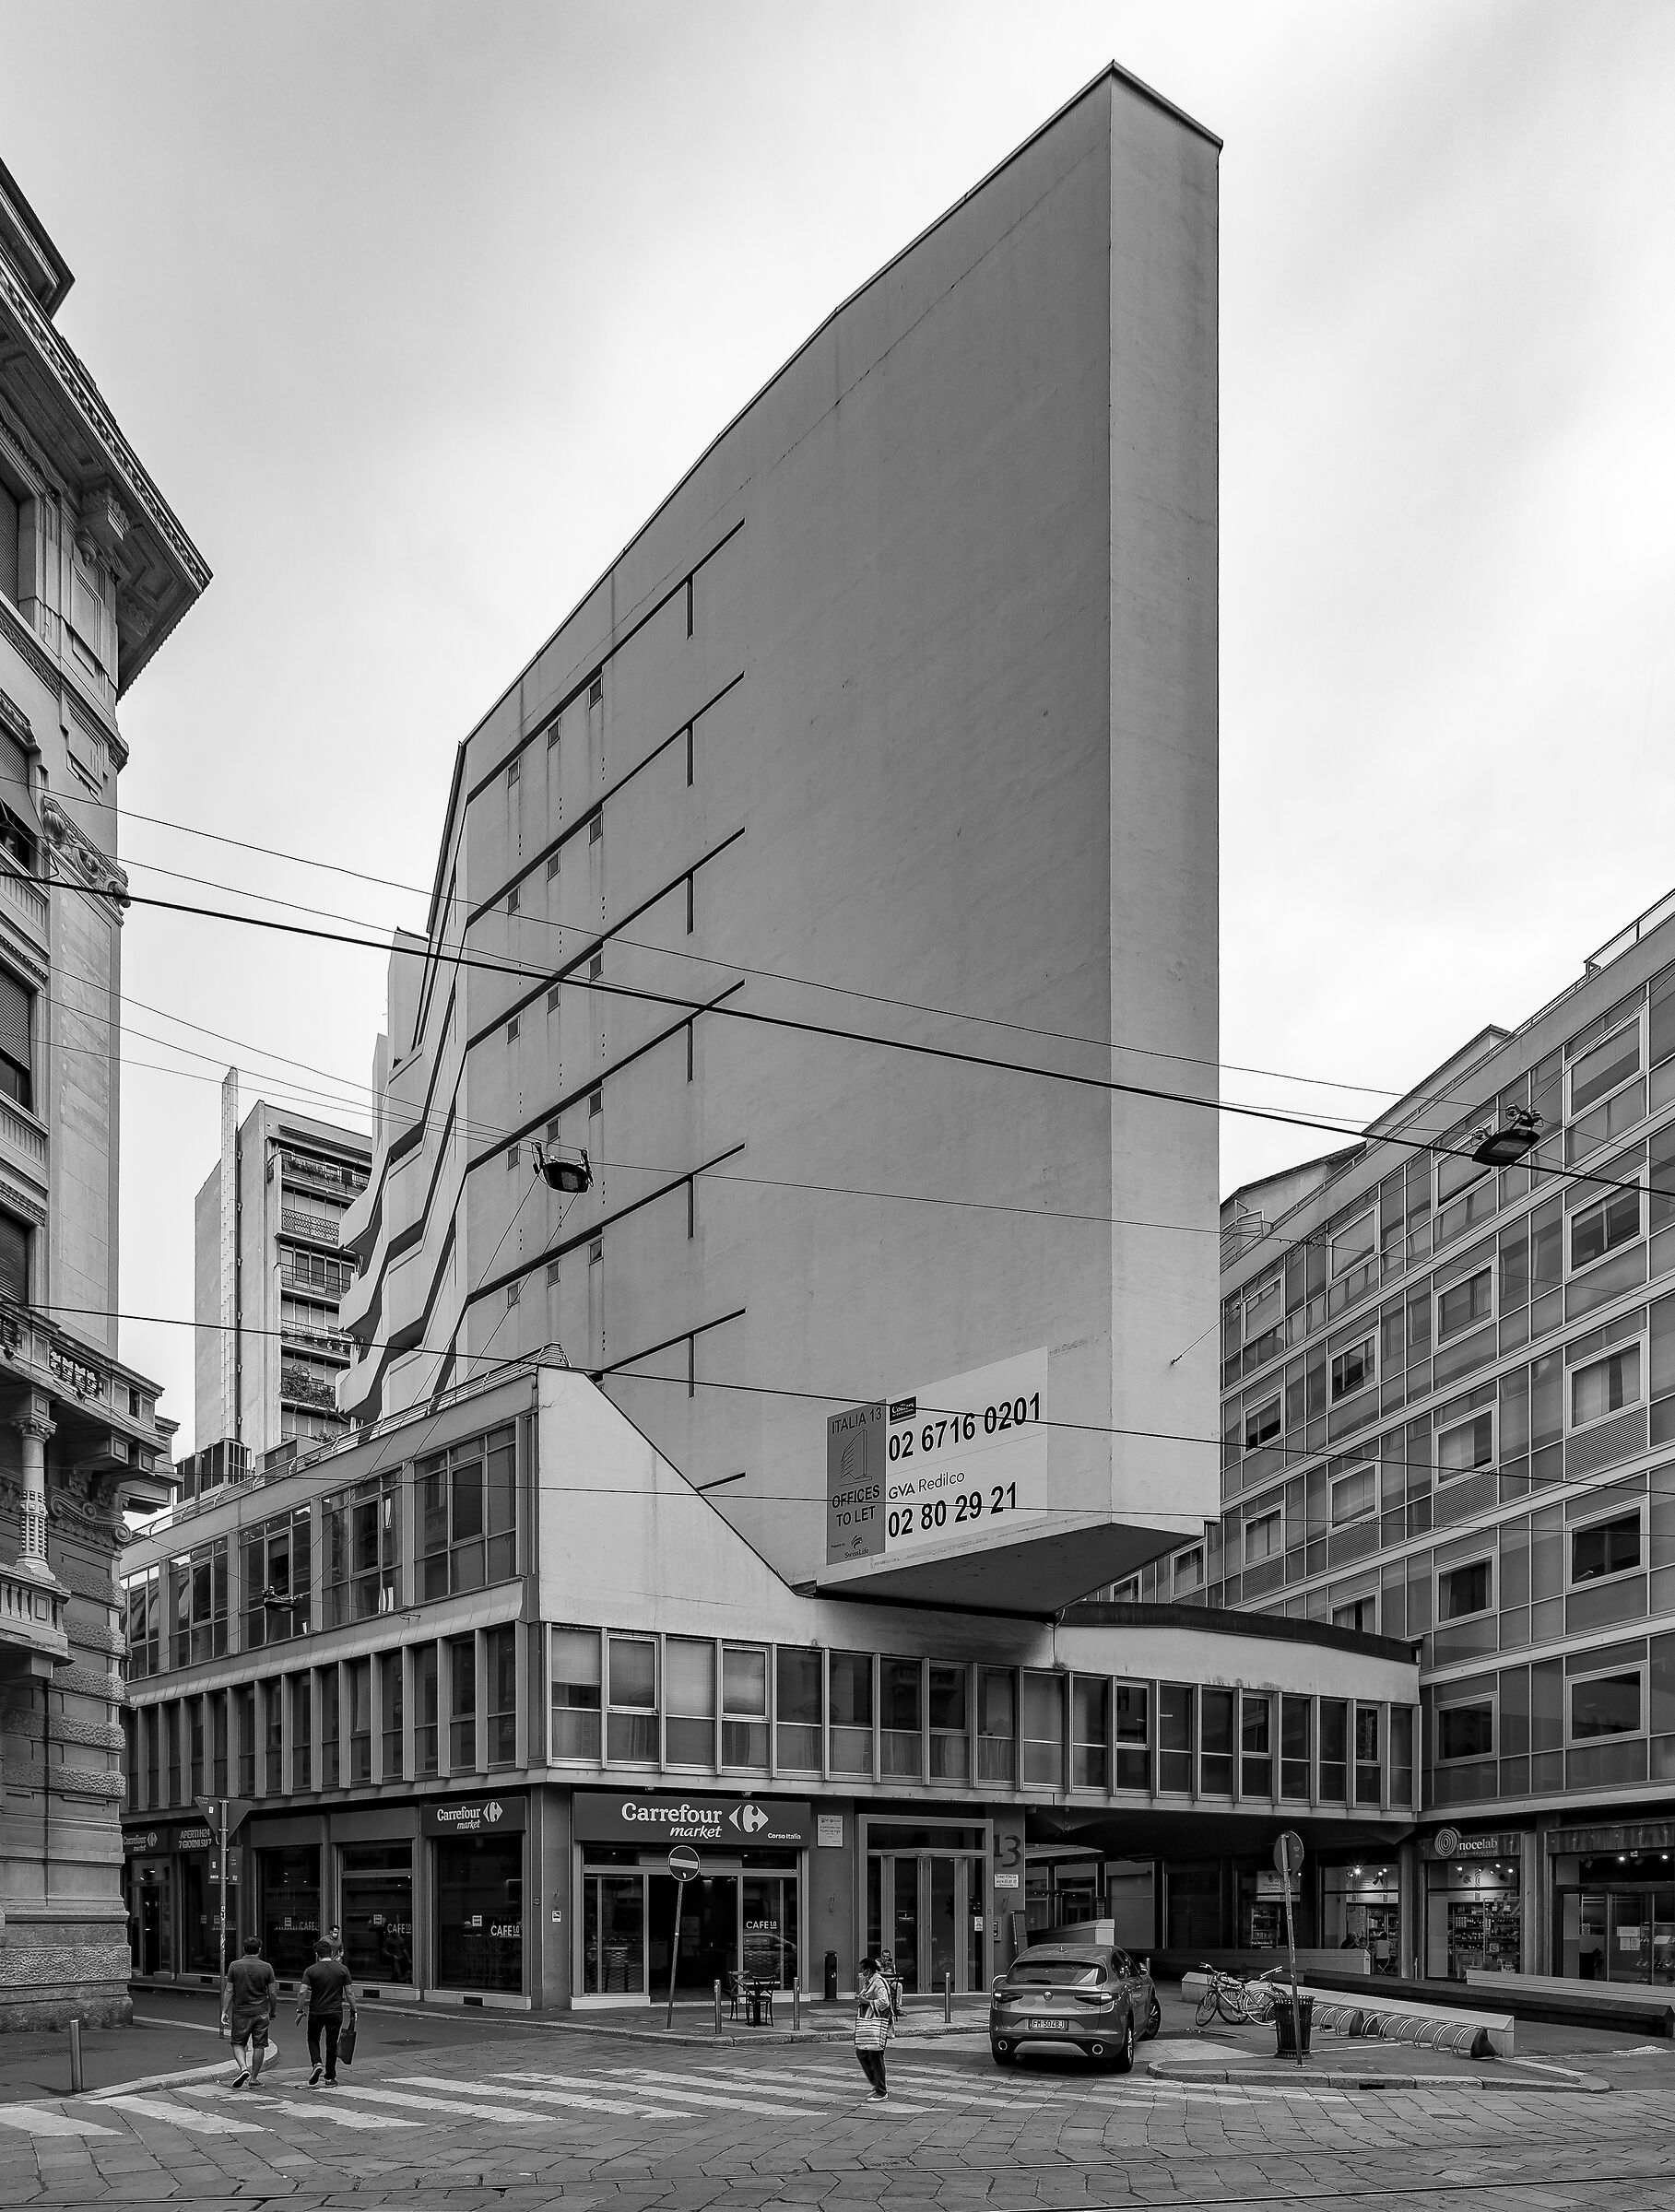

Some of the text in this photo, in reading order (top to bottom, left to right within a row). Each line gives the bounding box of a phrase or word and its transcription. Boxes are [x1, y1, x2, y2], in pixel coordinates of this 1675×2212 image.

[832, 1412, 867, 1434] ITALIA
[869, 1406, 882, 1422] 13
[889, 1392, 1040, 1462] 02 6716 0201
[889, 1472, 965, 1500] GVA Redilco
[832, 1484, 880, 1509] OFFICES
[836, 1505, 876, 1527] TO LET
[888, 1481, 1016, 1538] 02 80 29 21
[437, 1806, 481, 1821] Carrefour
[621, 1802, 723, 1824] Carrefour
[456, 1819, 481, 1830] market
[180, 1829, 210, 1840] APERTI H24
[669, 1825, 723, 1840] market
[178, 1841, 183, 1849] 7
[183, 1840, 200, 1849] GIORNI
[200, 1839, 208, 1848] SU
[994, 1834, 1021, 1867] 13
[1458, 1838, 1498, 1851] nocelab
[387, 1924, 406, 1934] CAFE
[490, 1924, 513, 1936] CAFE
[746, 1921, 769, 1929] CAFE
